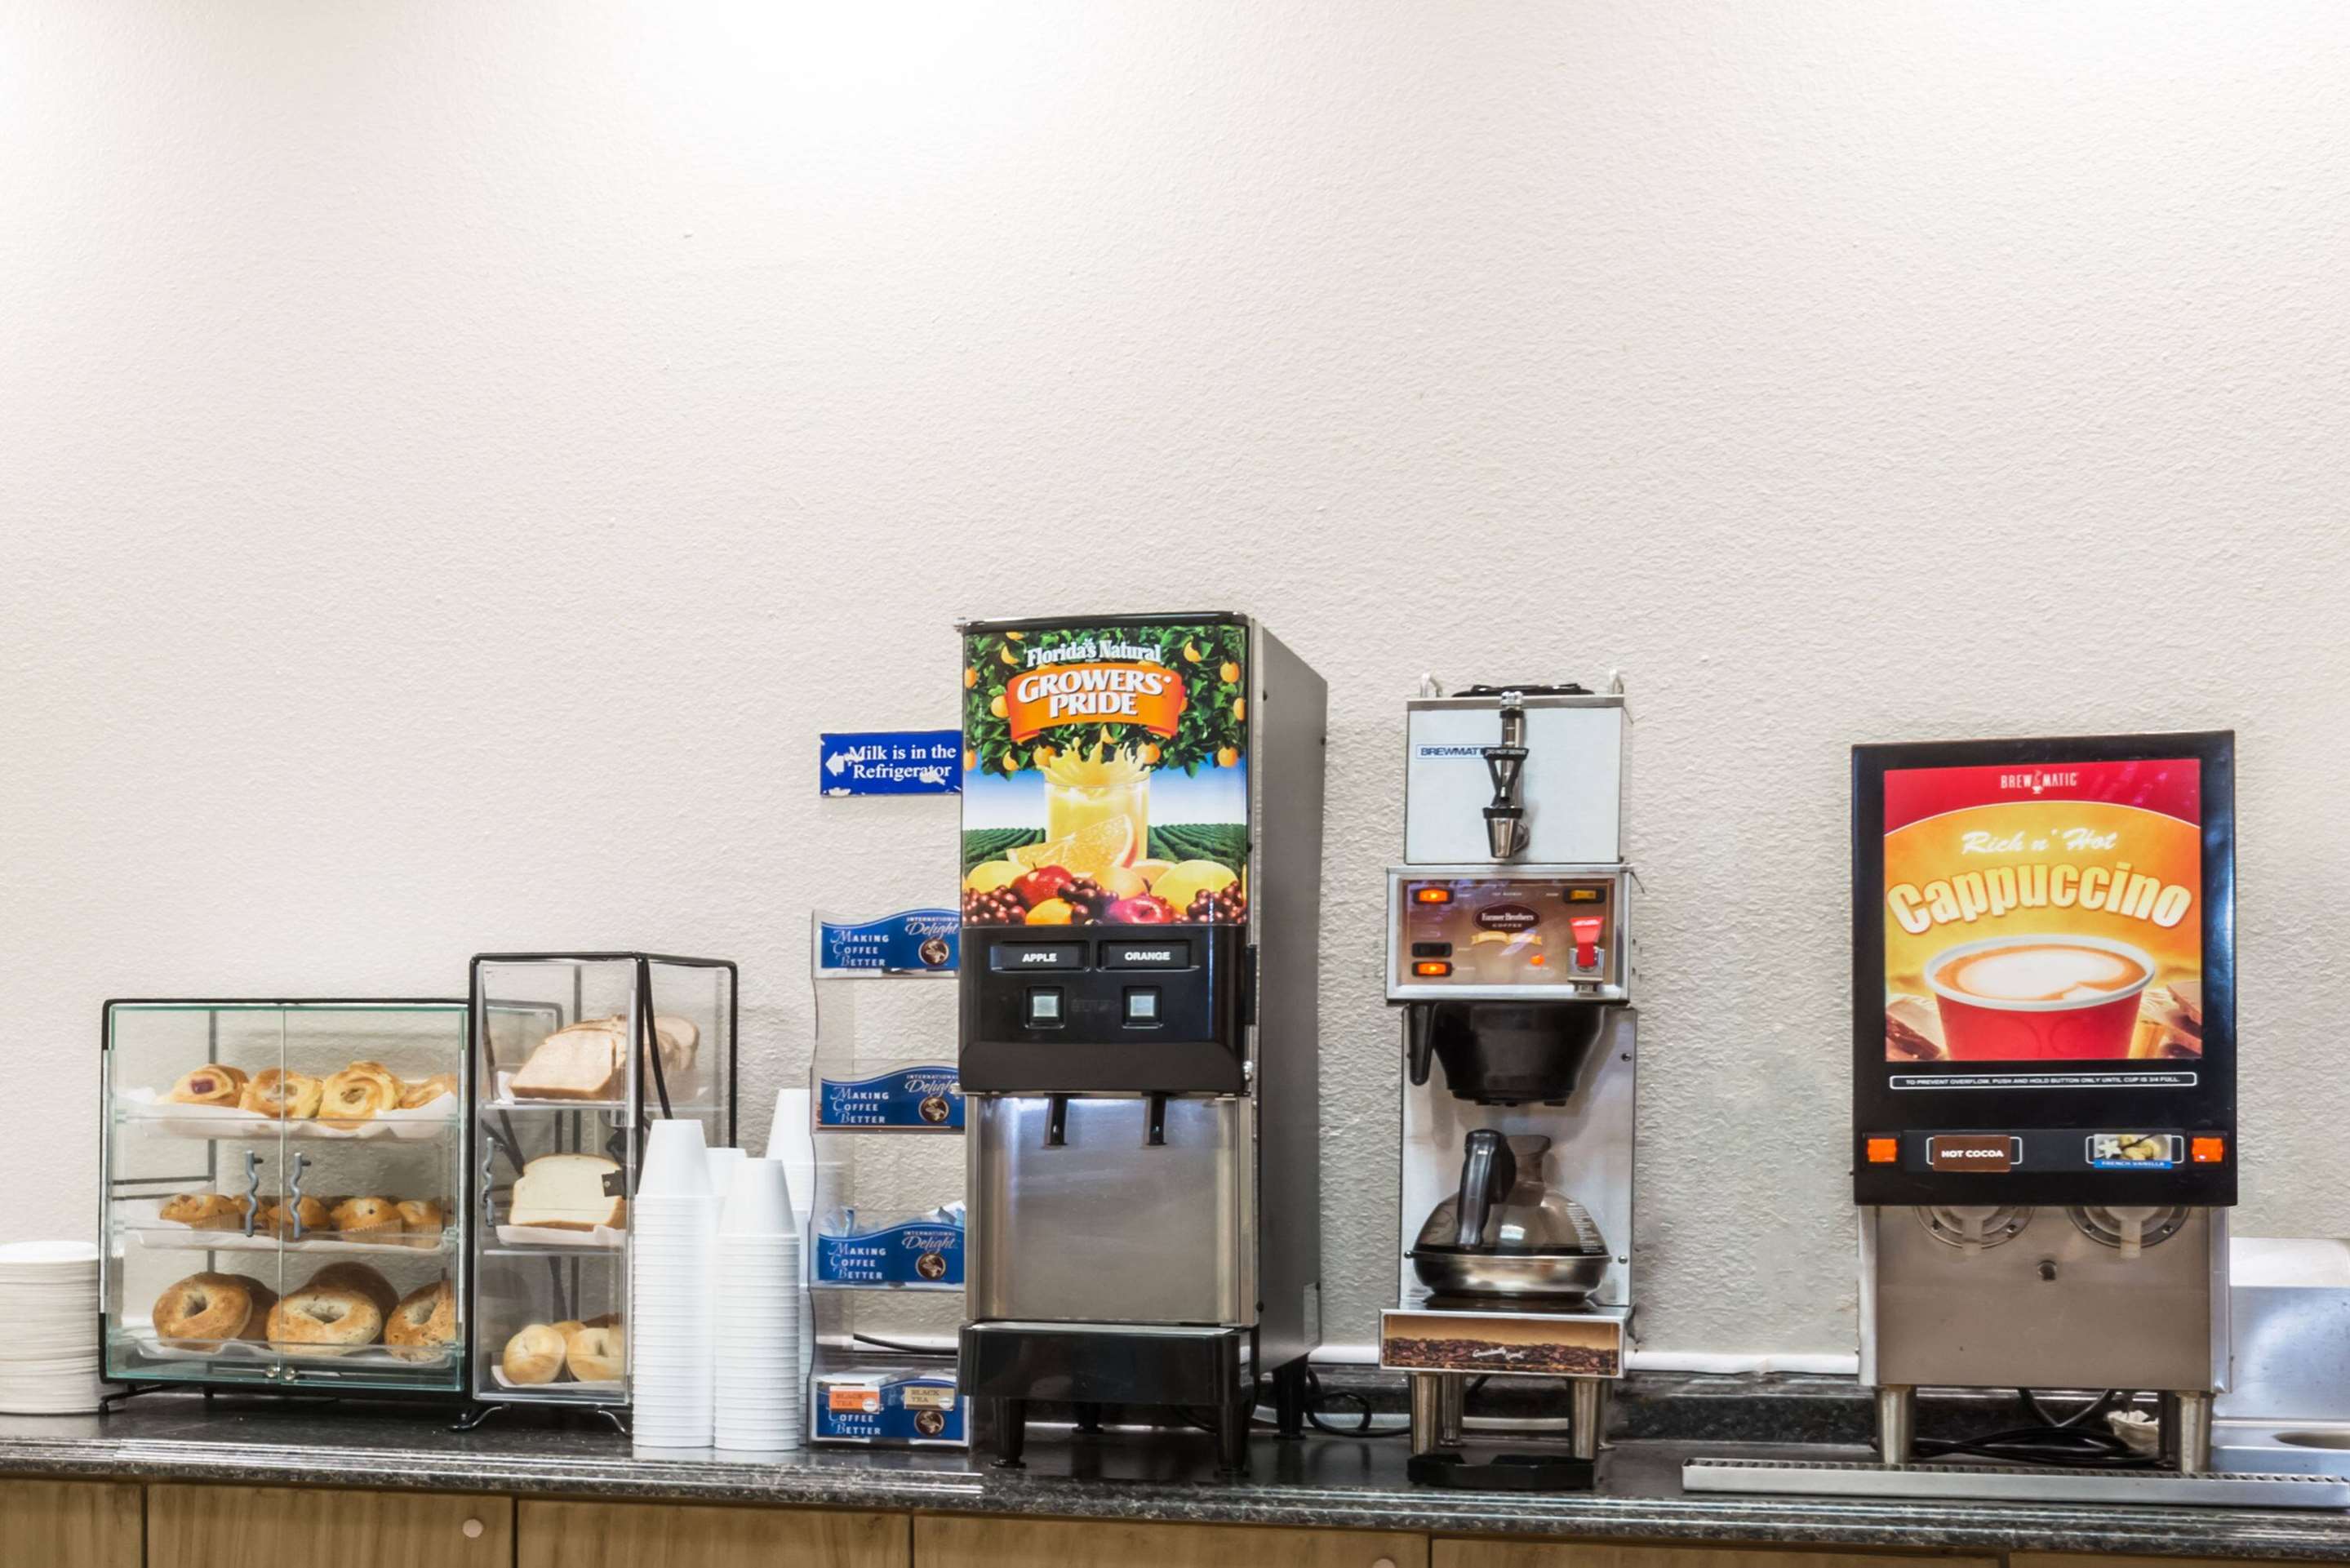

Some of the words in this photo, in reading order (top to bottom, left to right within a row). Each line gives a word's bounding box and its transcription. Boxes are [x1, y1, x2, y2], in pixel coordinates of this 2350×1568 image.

[1027, 638, 1096, 667] Florida's
[1099, 640, 1162, 664] Natural
[1050, 691, 1138, 718] PRIDE
[848, 745, 887, 761] Milk
[893, 745, 906, 759] is
[911, 744, 926, 759] in
[931, 744, 957, 758] the
[853, 763, 952, 781] Refrigerator
[1961, 830, 2025, 855] Rich
[2063, 828, 2119, 851] Hot
[1887, 861, 2192, 934] Cappuccino
[905, 922, 958, 939] Delight
[1022, 953, 1058, 962] APPLE
[1125, 951, 1171, 961] ORANGE
[901, 1236, 955, 1254] Delight
